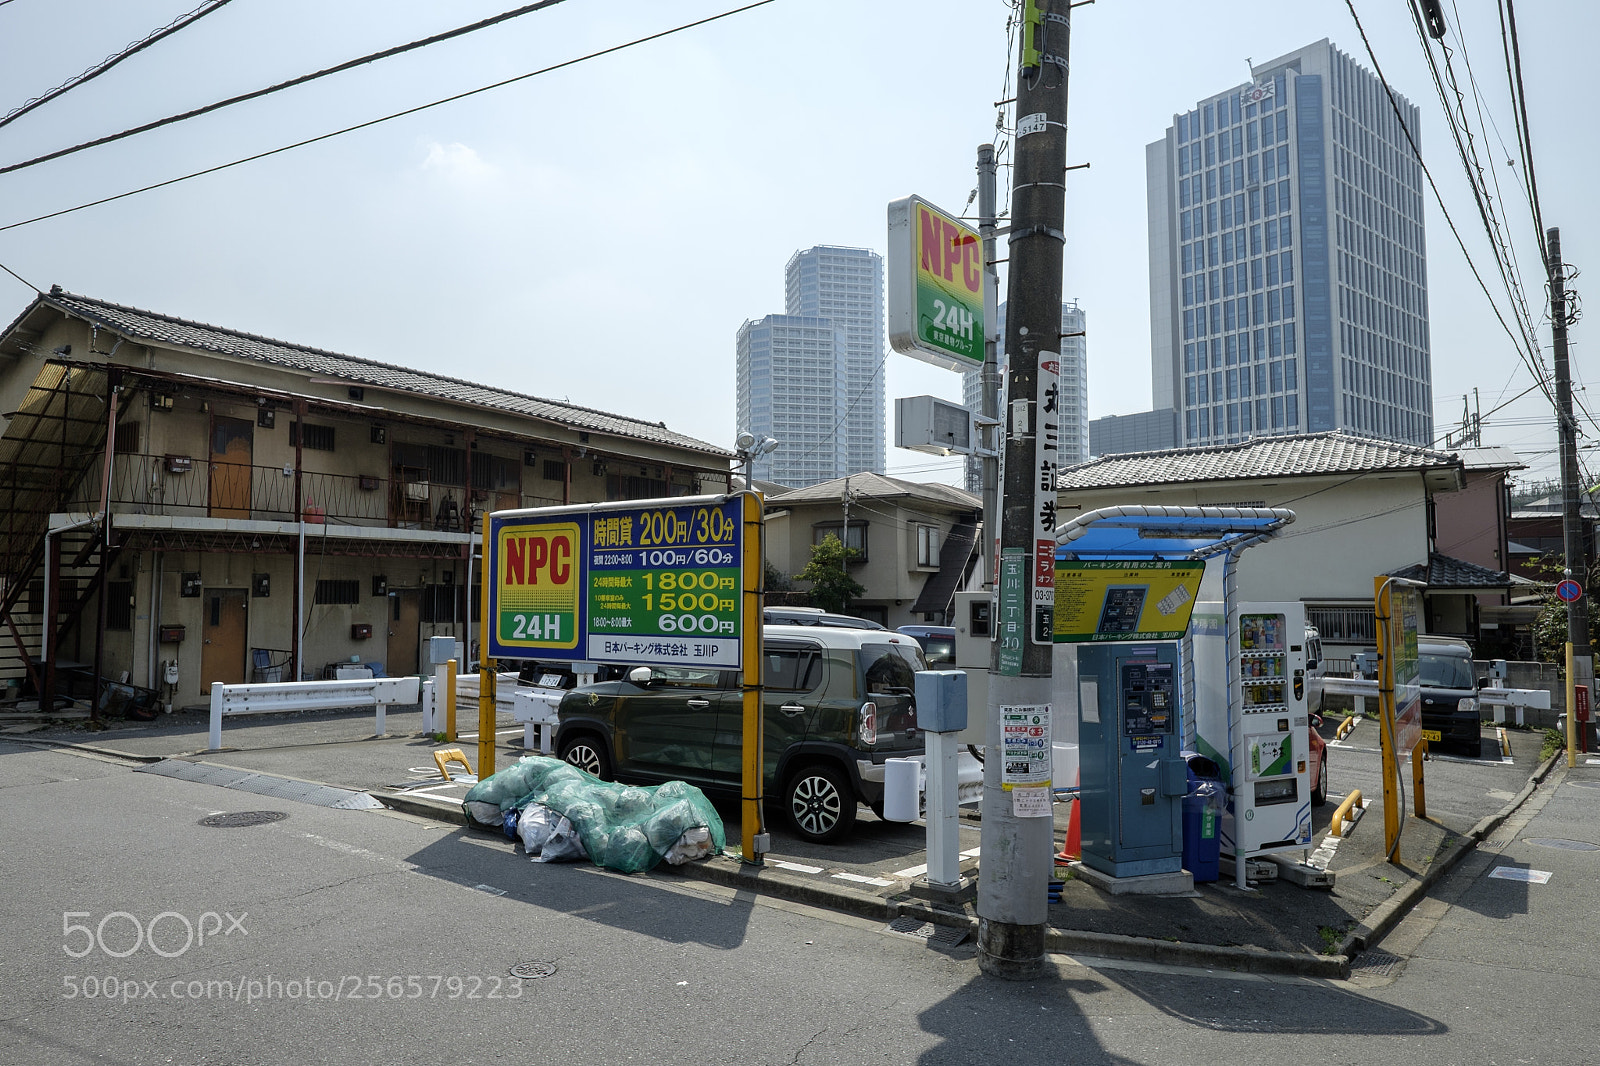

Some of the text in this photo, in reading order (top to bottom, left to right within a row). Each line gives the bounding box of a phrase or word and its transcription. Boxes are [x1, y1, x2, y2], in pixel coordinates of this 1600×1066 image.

[920, 208, 980, 293] NPC
[933, 299, 973, 341] 24H
[594, 507, 735, 546] 時間貸 200円/30分
[505, 535, 571, 586] NPC
[639, 548, 734, 566] 100円/60分
[1083, 561, 1172, 569] パーキング利用のご案内
[641, 571, 735, 590] 1800円
[641, 593, 735, 612] 1500円
[1006, 563, 1018, 633] 玉川二丁目
[512, 614, 561, 640] 24H
[658, 613, 735, 634] 600円
[604, 641, 719, 657] 日本パーキング株式会社 玉川P
